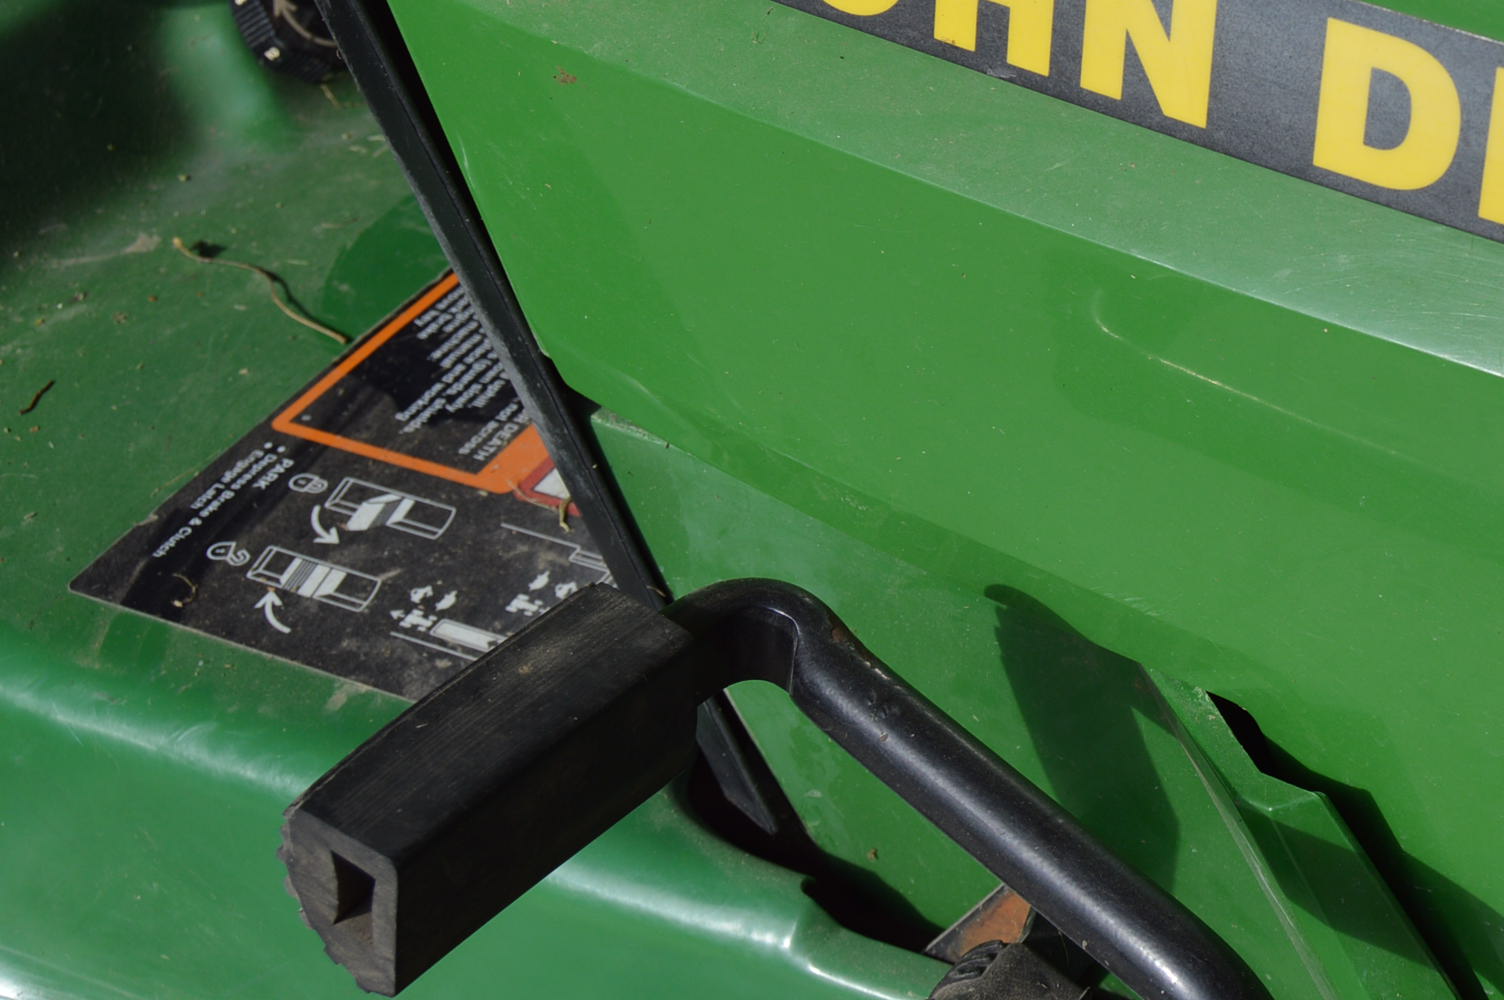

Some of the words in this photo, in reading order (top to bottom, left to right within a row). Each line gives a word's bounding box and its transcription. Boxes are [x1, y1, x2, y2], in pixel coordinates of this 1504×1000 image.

[394, 382, 446, 422] working
[444, 383, 483, 414] slowly
[495, 402, 518, 421] not
[458, 420, 500, 456] across
[473, 422, 519, 461] DEATH
[220, 449, 265, 483] Engage
[230, 453, 277, 490] Depress
[253, 457, 295, 490] PARK
[190, 483, 226, 509] Latch
[198, 489, 235, 518] Brake
[188, 516, 203, 527] &
[152, 525, 193, 558] Clutch
